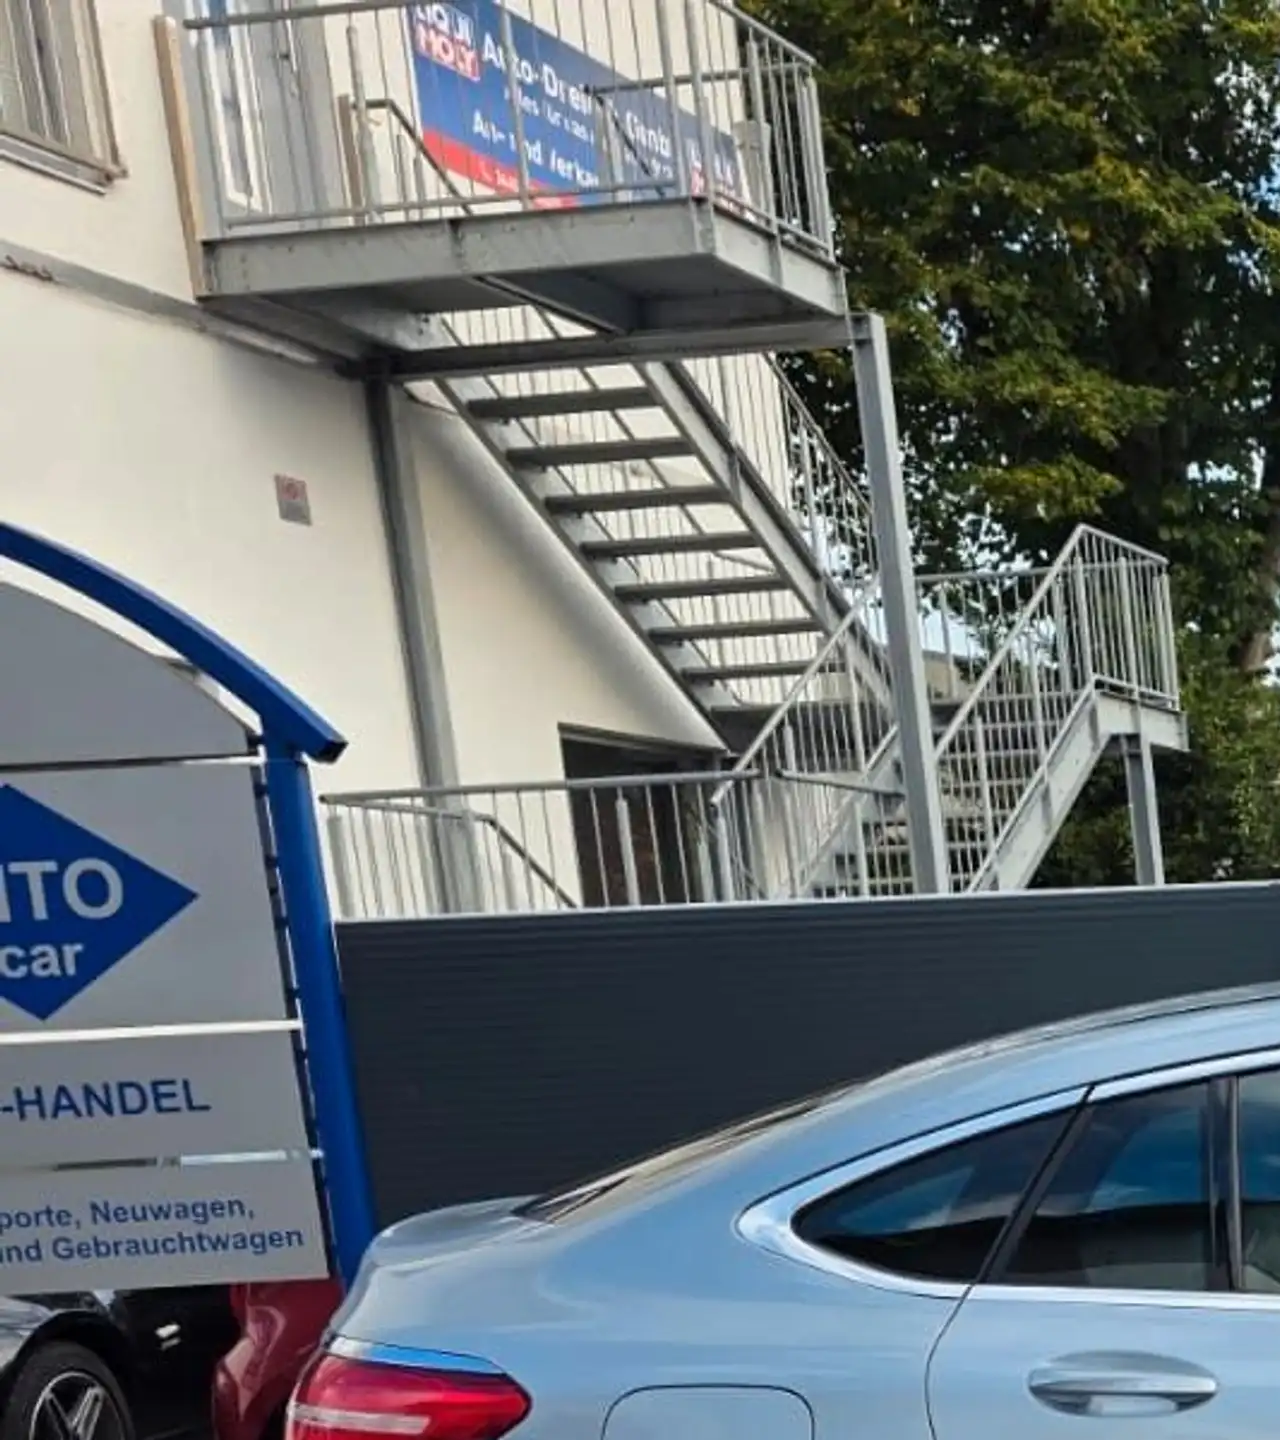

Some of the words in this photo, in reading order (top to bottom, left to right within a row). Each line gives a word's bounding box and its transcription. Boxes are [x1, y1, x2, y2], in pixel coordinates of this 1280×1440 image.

[414, 22, 479, 80] MOLY
[0, 943, 84, 979] car
[1, 1077, 212, 1122] -HANDEL
[90, 1199, 255, 1225] Neuwagen,
[52, 1229, 305, 1260] Gebrauchtwagen
